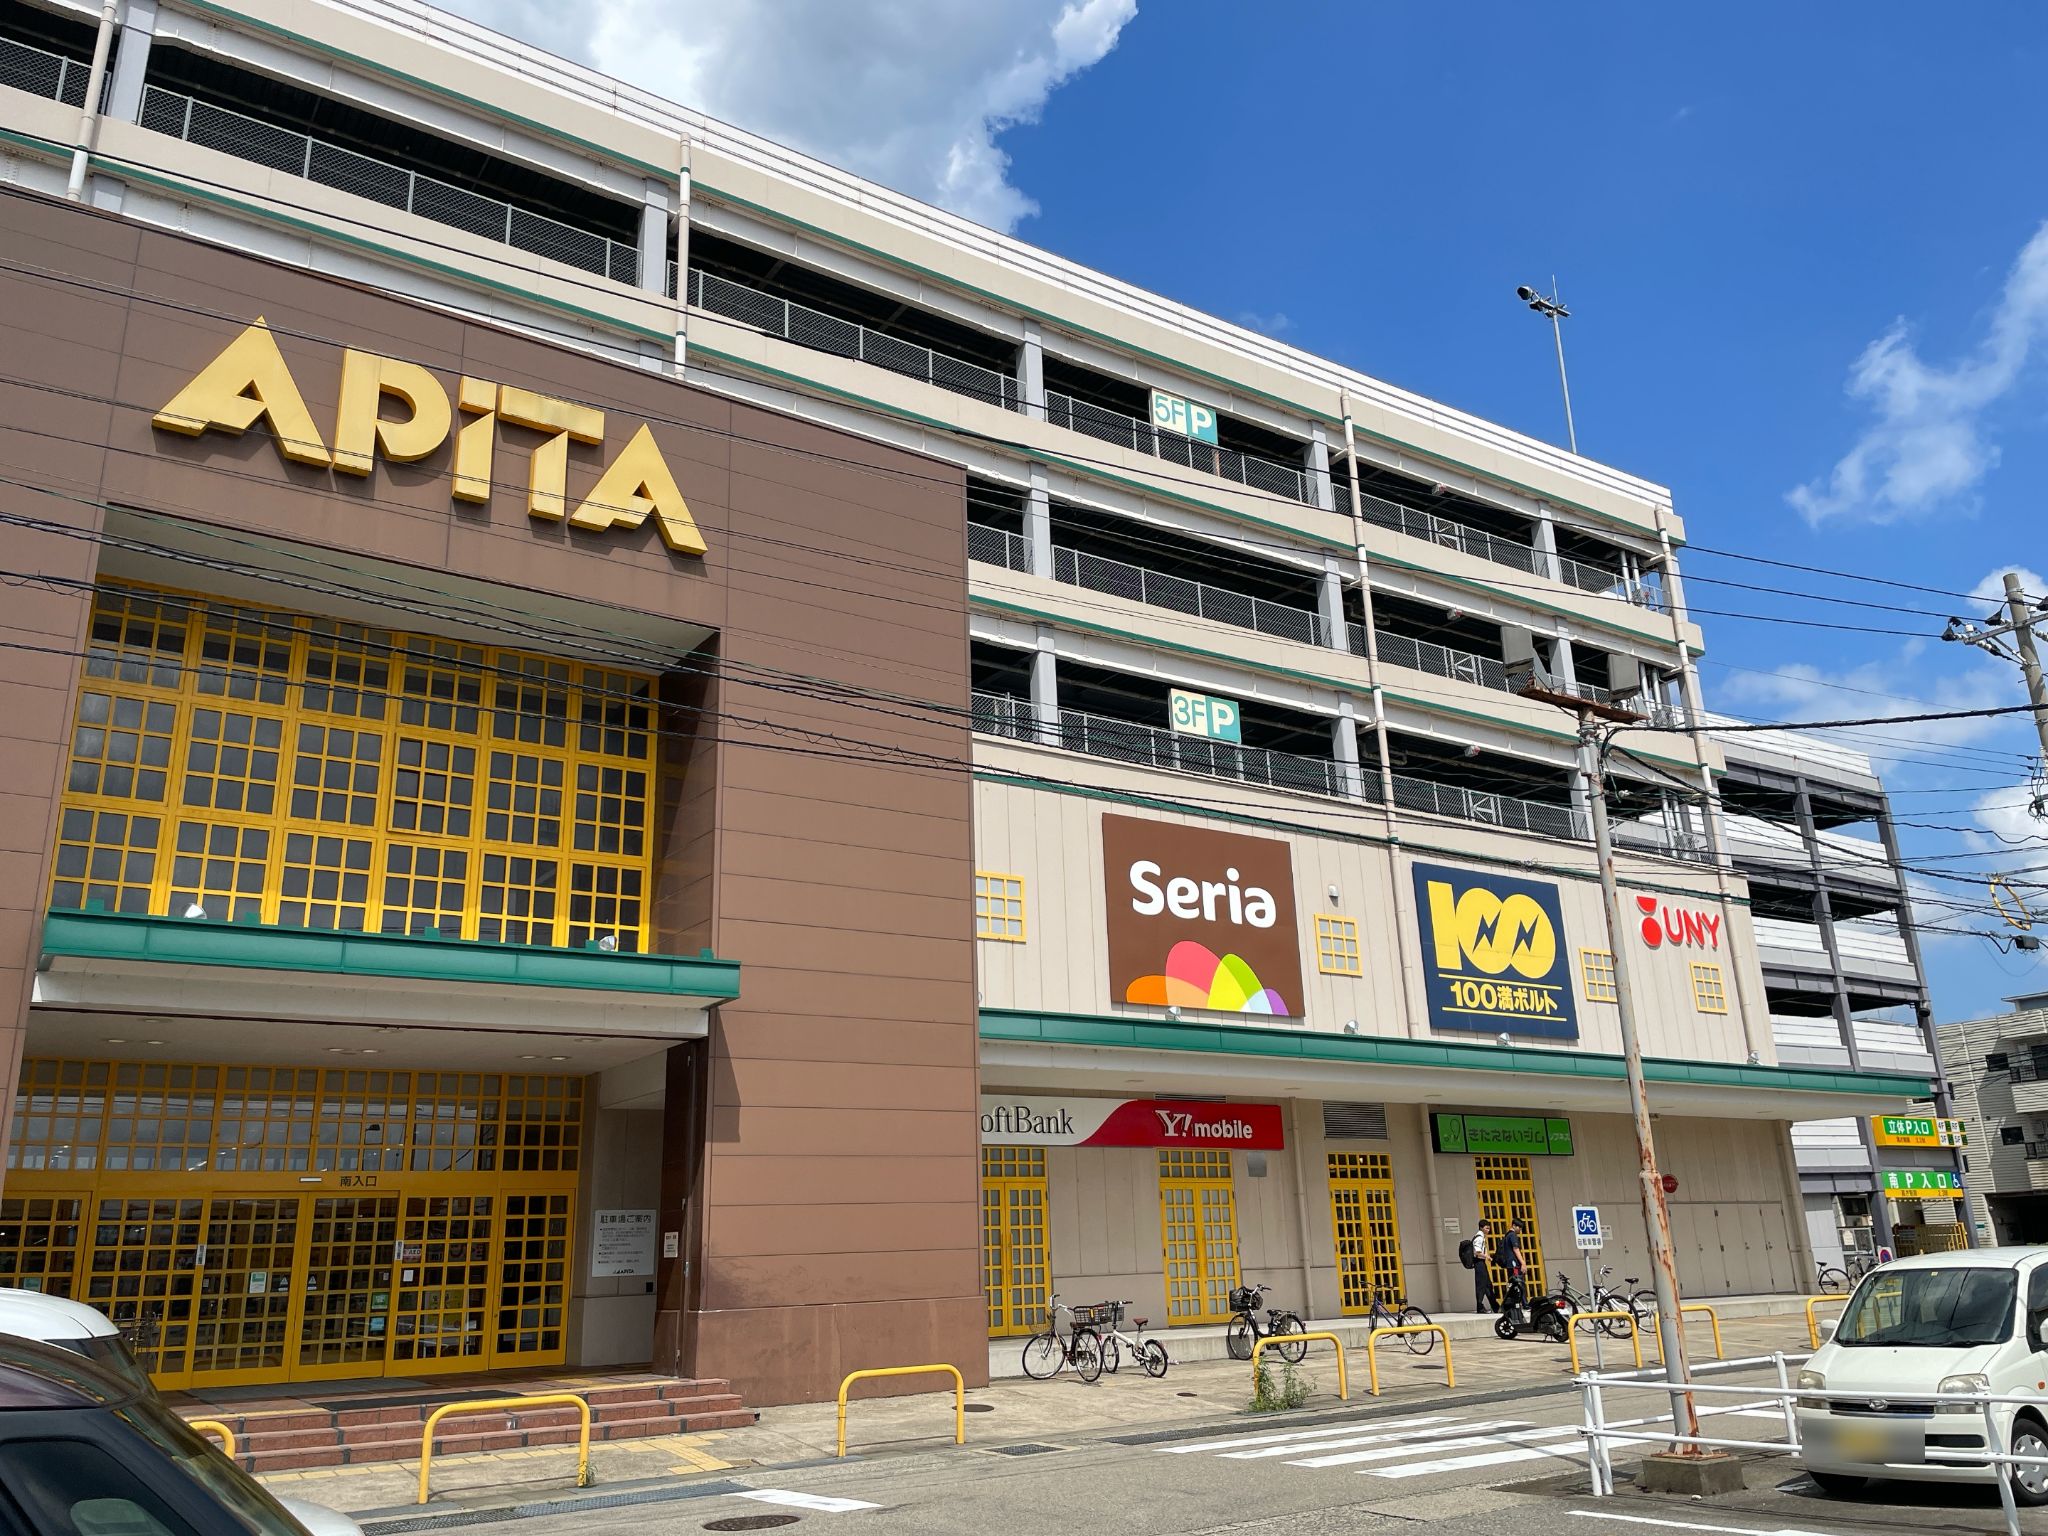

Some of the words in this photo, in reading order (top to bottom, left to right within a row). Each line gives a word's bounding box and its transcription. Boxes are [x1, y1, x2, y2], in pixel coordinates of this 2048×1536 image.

[151, 315, 708, 556] APITA
[1129, 860, 1277, 928] Seria
[1662, 905, 1720, 949] UNY
[1450, 981, 1558, 1015] 100満ボルト
[980, 1105, 1075, 1135] oftBank
[1888, 1120, 1930, 1135] 立体P入口
[1468, 1127, 1546, 1144] きたえないジム
[340, 1175, 378, 1187] 南入口
[1888, 1172, 1947, 1189] 南P入口
